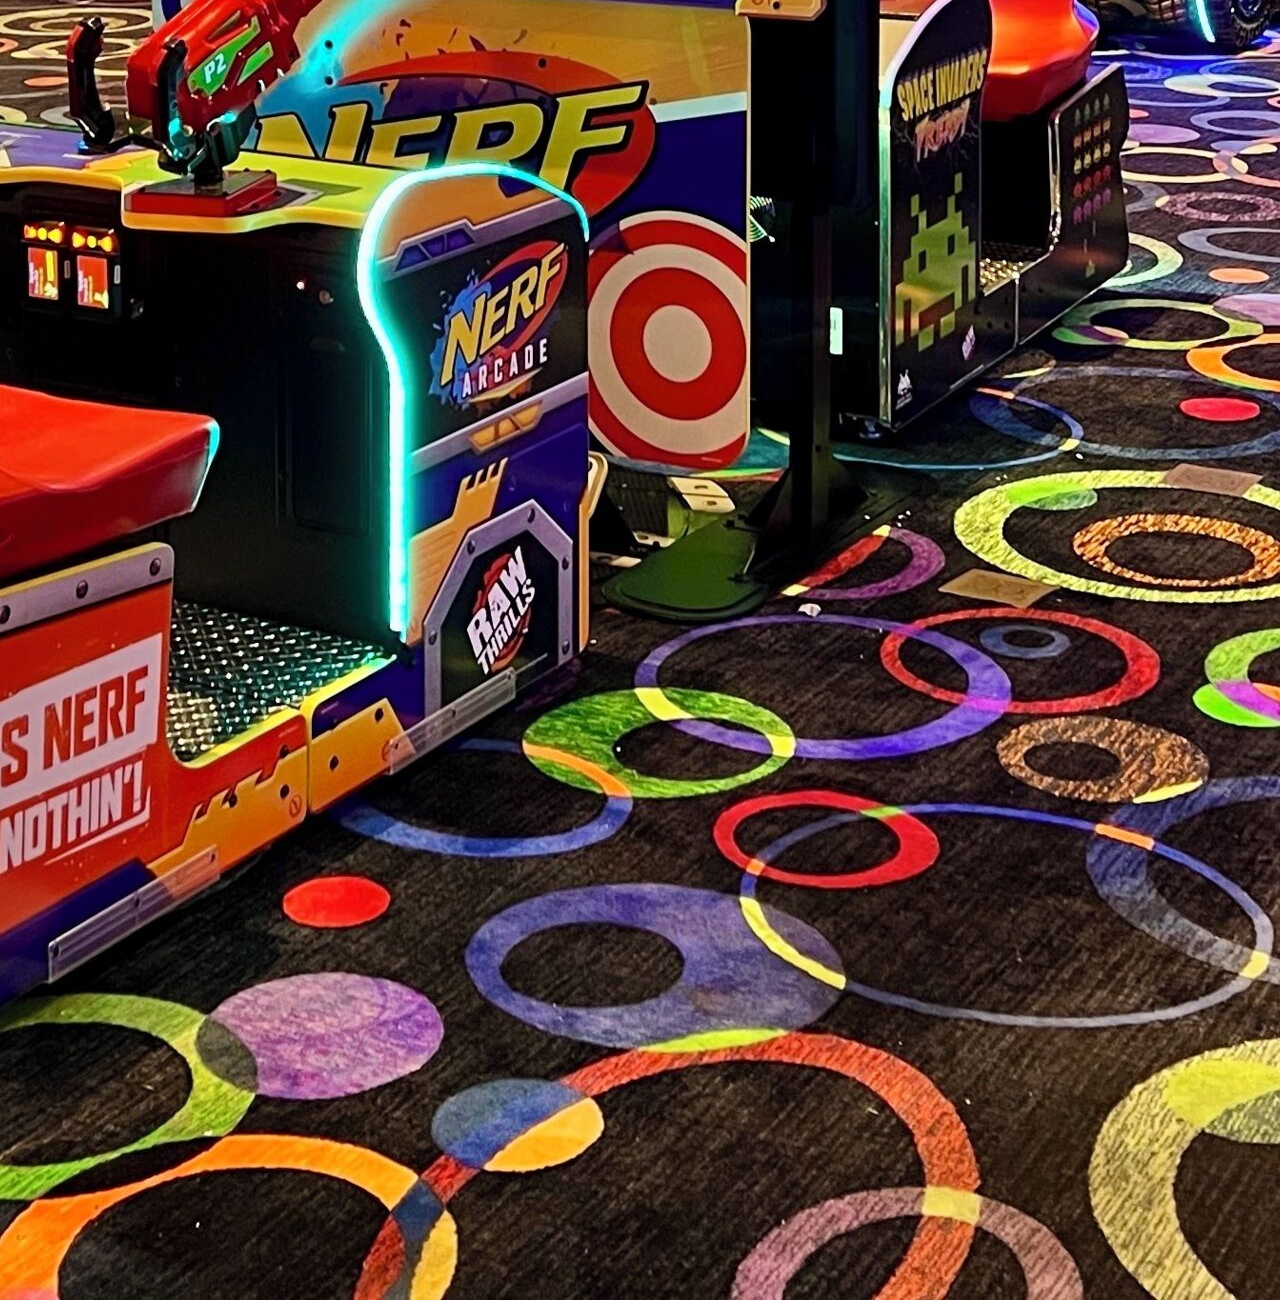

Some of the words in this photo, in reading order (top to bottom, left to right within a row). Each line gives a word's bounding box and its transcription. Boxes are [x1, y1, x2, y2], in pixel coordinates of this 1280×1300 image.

[203, 54, 228, 84] P2
[897, 67, 935, 122] SPACE
[935, 48, 987, 108] INVADERS
[440, 243, 565, 386] NERF
[462, 338, 547, 397] ARCADE
[467, 545, 527, 659] RAW
[477, 579, 535, 674] THRILLS
[43, 664, 149, 770] NERF
